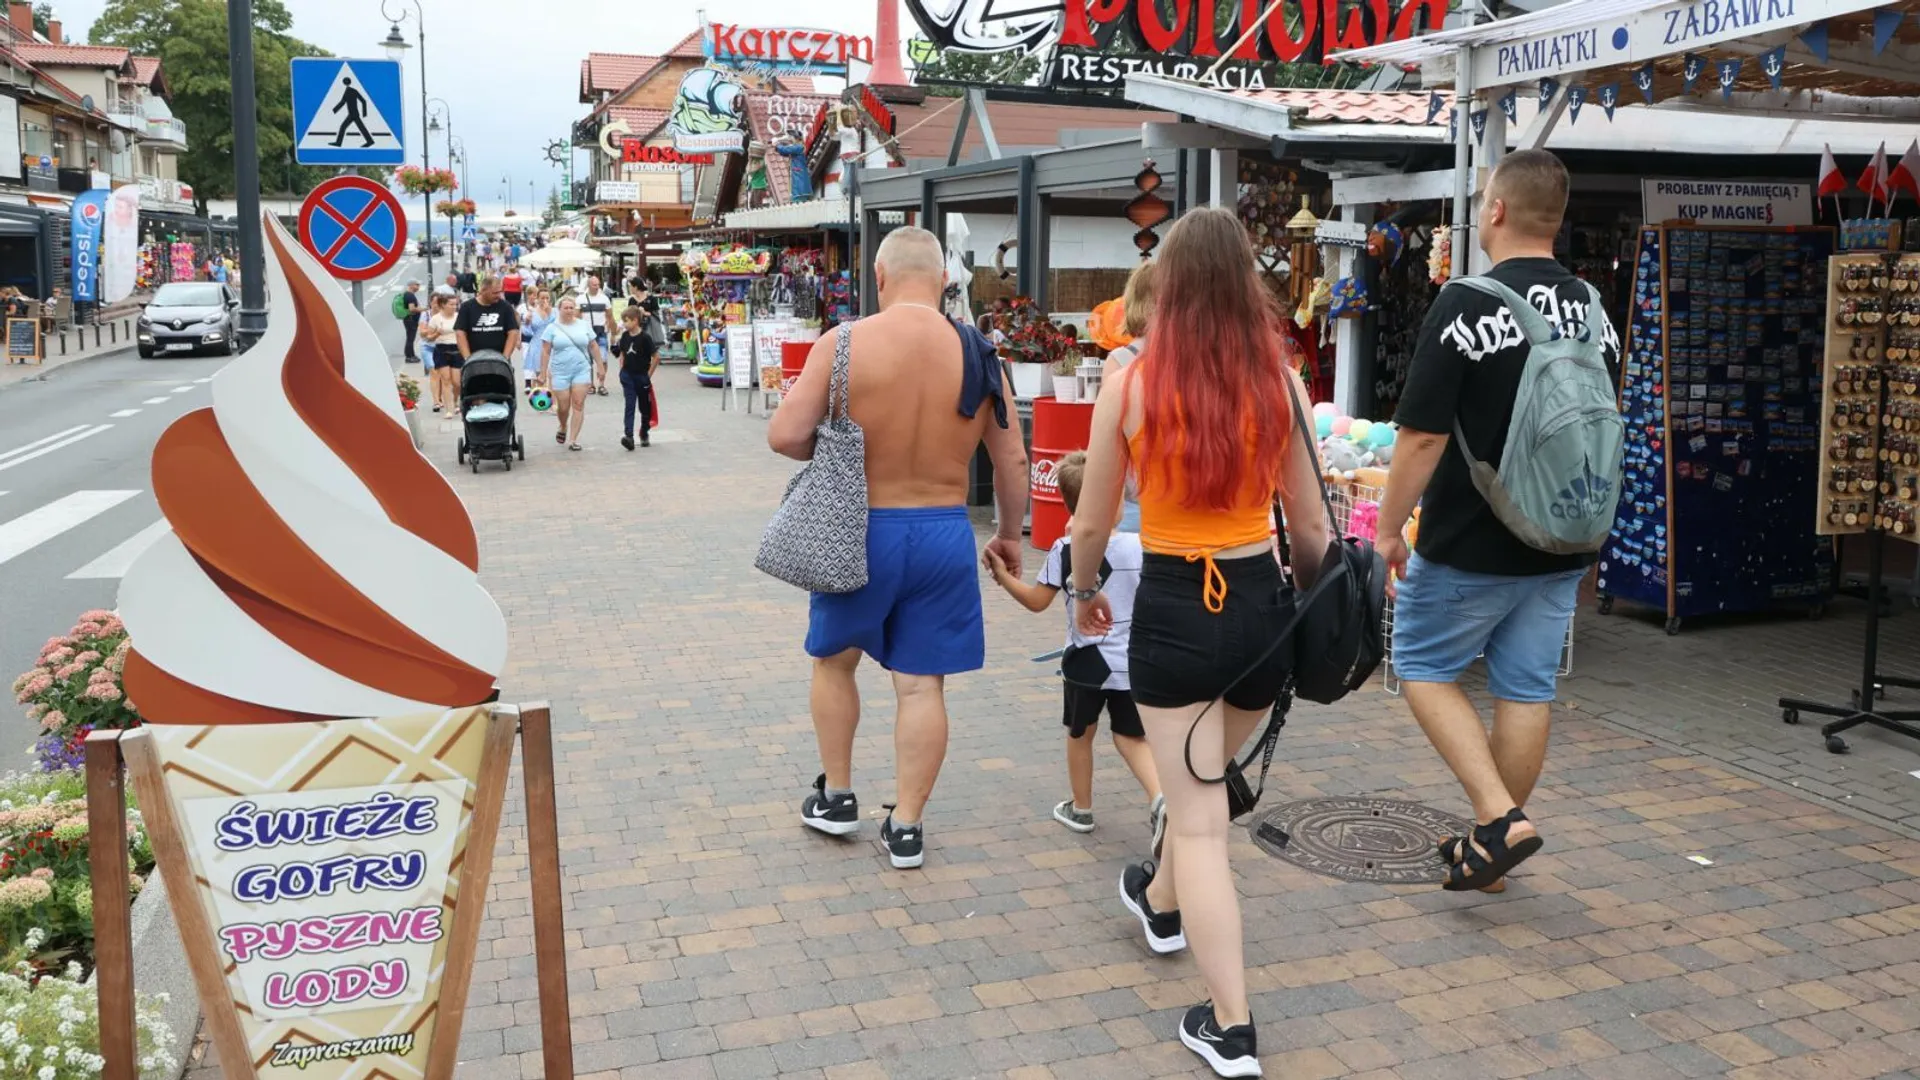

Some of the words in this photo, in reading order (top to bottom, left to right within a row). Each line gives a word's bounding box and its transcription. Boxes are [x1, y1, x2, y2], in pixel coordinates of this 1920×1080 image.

[1497, 28, 1598, 77] PAMIĄTKI
[1657, 182, 1722, 196] PROBLEMY
[1725, 184, 1733, 196] Z
[1735, 184, 1792, 200] PAMIĘCIĄ
[1794, 186, 1799, 198] ?
[1678, 204, 1708, 219] KUP
[1712, 203, 1773, 224] MAGNES
[76, 233, 93, 296] pepsi
[1440, 307, 1525, 362] Los
[217, 793, 437, 849] ŚWIEŻE
[234, 852, 425, 902] GOFRY
[221, 907, 442, 960] PYSZNE
[266, 960, 407, 1007] LODY
[271, 1032, 414, 1069] Zapraszamy
